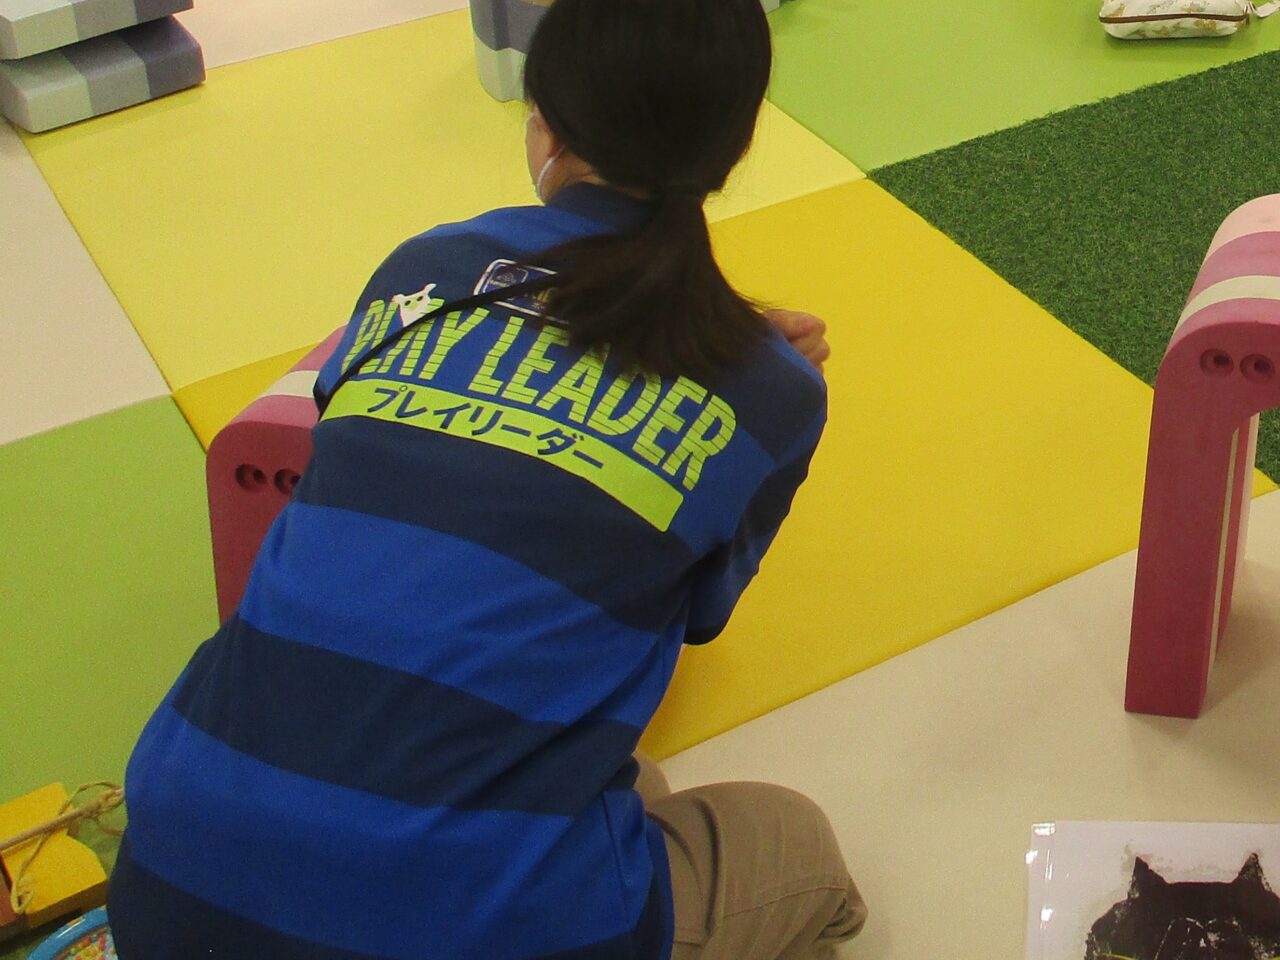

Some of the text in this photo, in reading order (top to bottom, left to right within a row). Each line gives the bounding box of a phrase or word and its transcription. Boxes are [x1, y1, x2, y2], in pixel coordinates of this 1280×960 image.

[366, 385, 604, 470] プレイリーダー
[467, 316, 737, 491] LEADER
